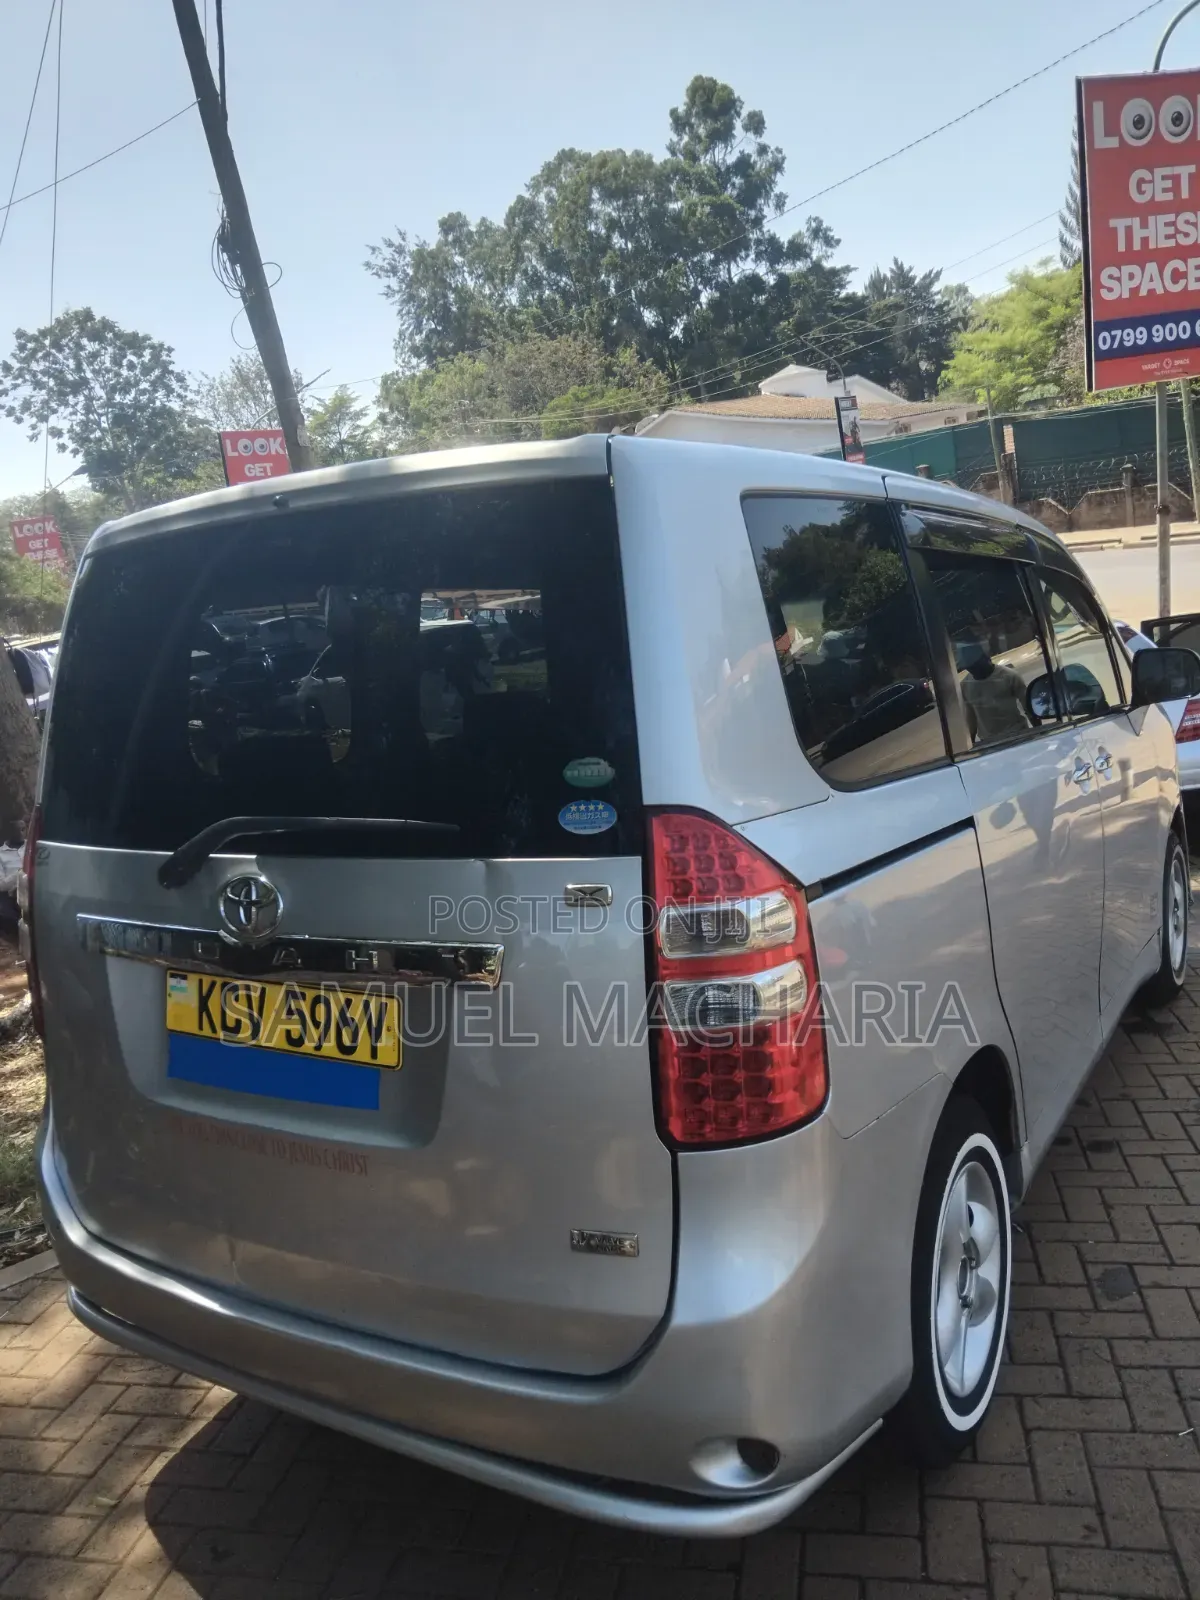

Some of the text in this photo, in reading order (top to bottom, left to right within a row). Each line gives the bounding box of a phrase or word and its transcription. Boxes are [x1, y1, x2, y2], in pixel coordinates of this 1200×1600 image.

[1093, 95, 1200, 149] LOO
[1129, 164, 1196, 203] GET
[1109, 211, 1200, 252] THES
[1098, 327, 1148, 350] 0799
[1151, 320, 1191, 343] 900
[225, 436, 285, 456] LOOK
[244, 463, 273, 477] GET
[14, 520, 56, 538] LOOK
[29, 538, 49, 550] GET
